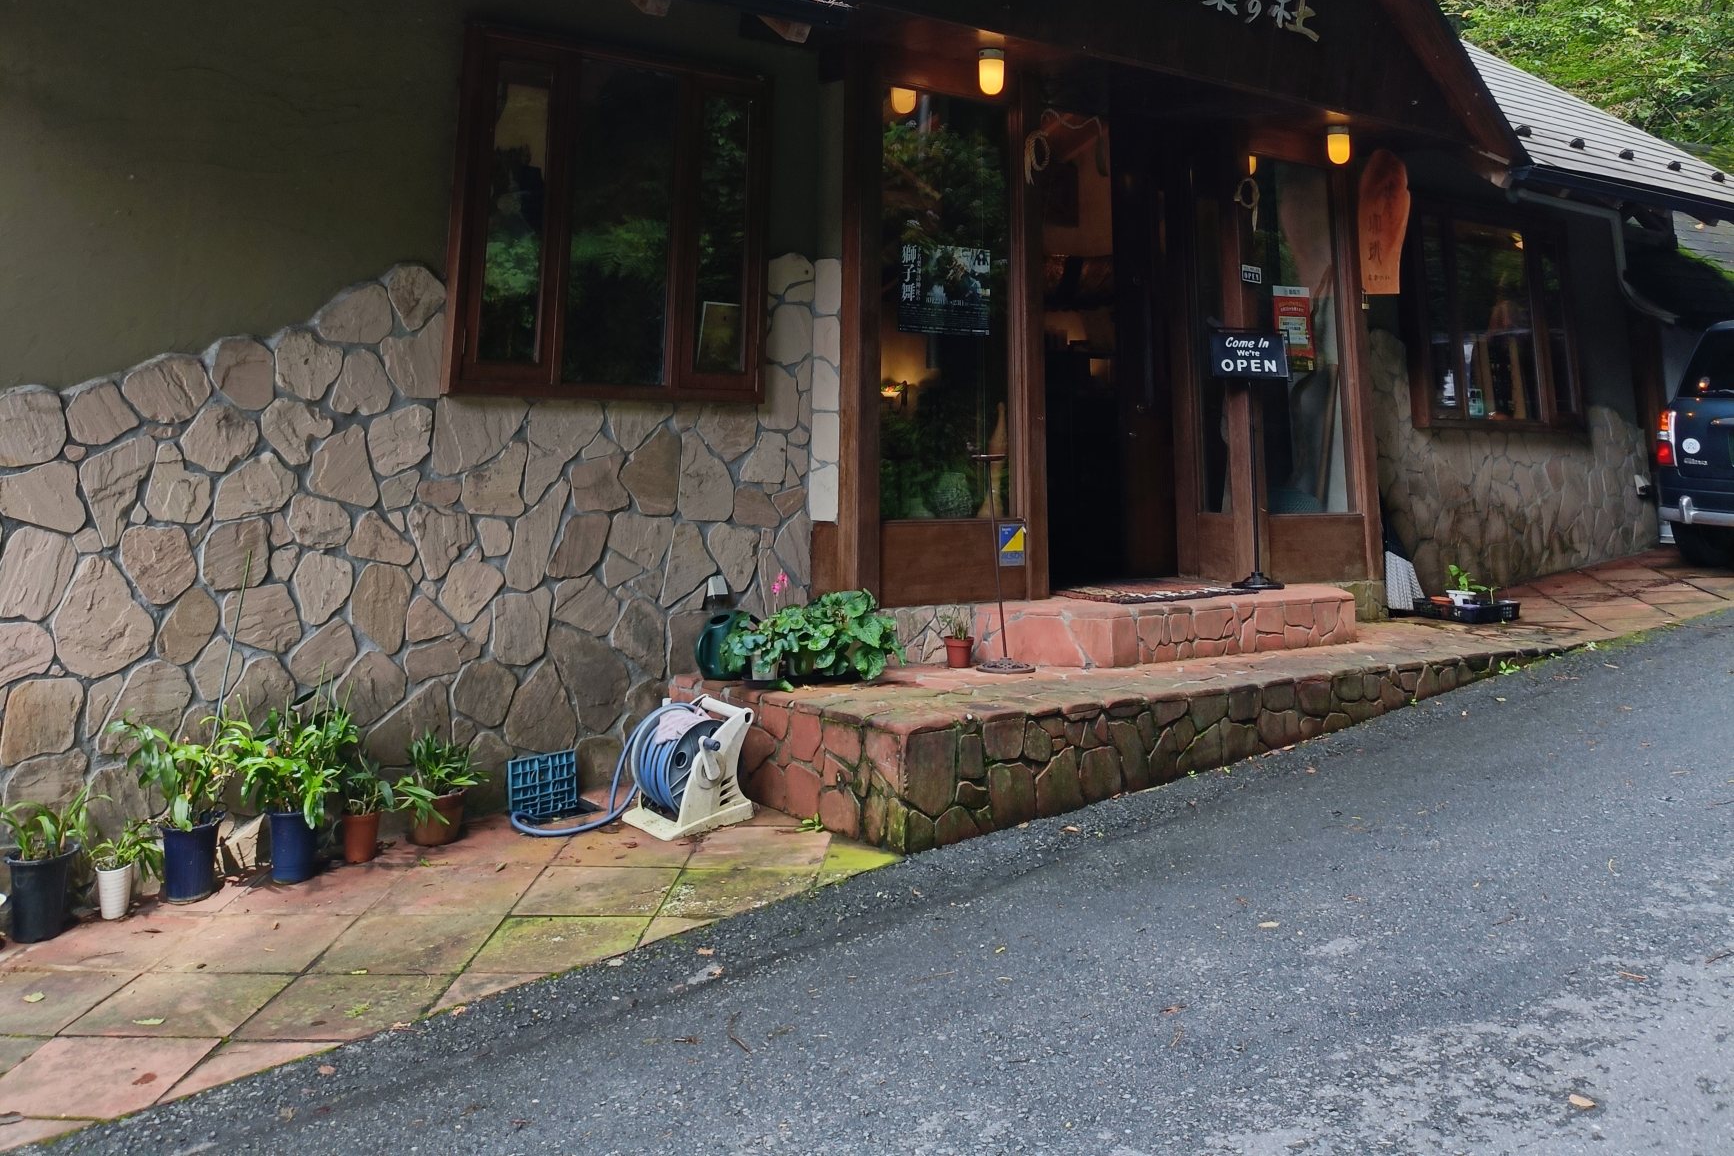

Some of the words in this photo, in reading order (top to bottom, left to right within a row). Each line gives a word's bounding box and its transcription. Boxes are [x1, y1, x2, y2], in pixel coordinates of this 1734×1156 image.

[902, 244, 917, 302] 獅子舞
[1225, 337, 1255, 348] Come
[1258, 337, 1270, 349] In
[1236, 349, 1260, 357] We're
[1221, 359, 1277, 373] OPEN
